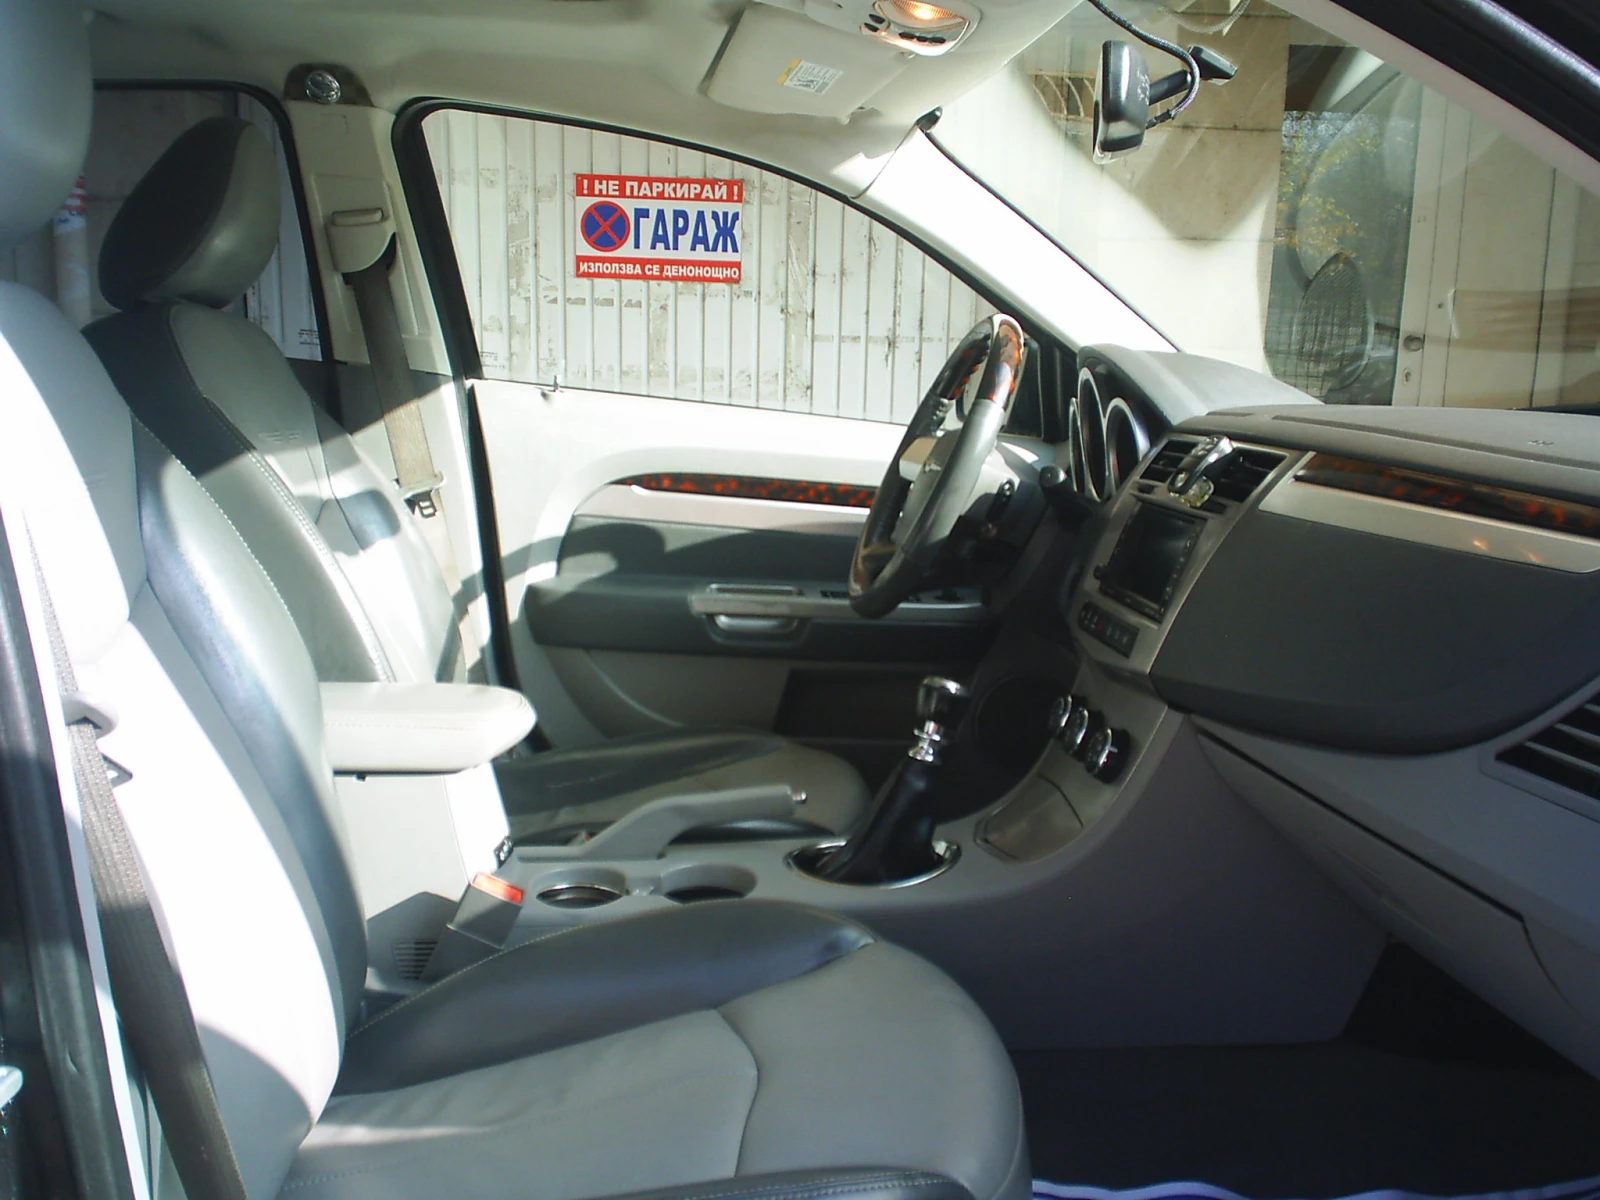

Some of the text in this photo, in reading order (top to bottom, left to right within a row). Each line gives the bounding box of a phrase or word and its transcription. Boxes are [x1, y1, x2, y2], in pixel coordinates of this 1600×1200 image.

[582, 179, 739, 200] ! НЕ ПАРКИРАЙ !
[633, 207, 740, 253] ГАРАЖ
[579, 261, 739, 279] ИЗПОЛЗВА СЕ ДЕНОНОЩНО
